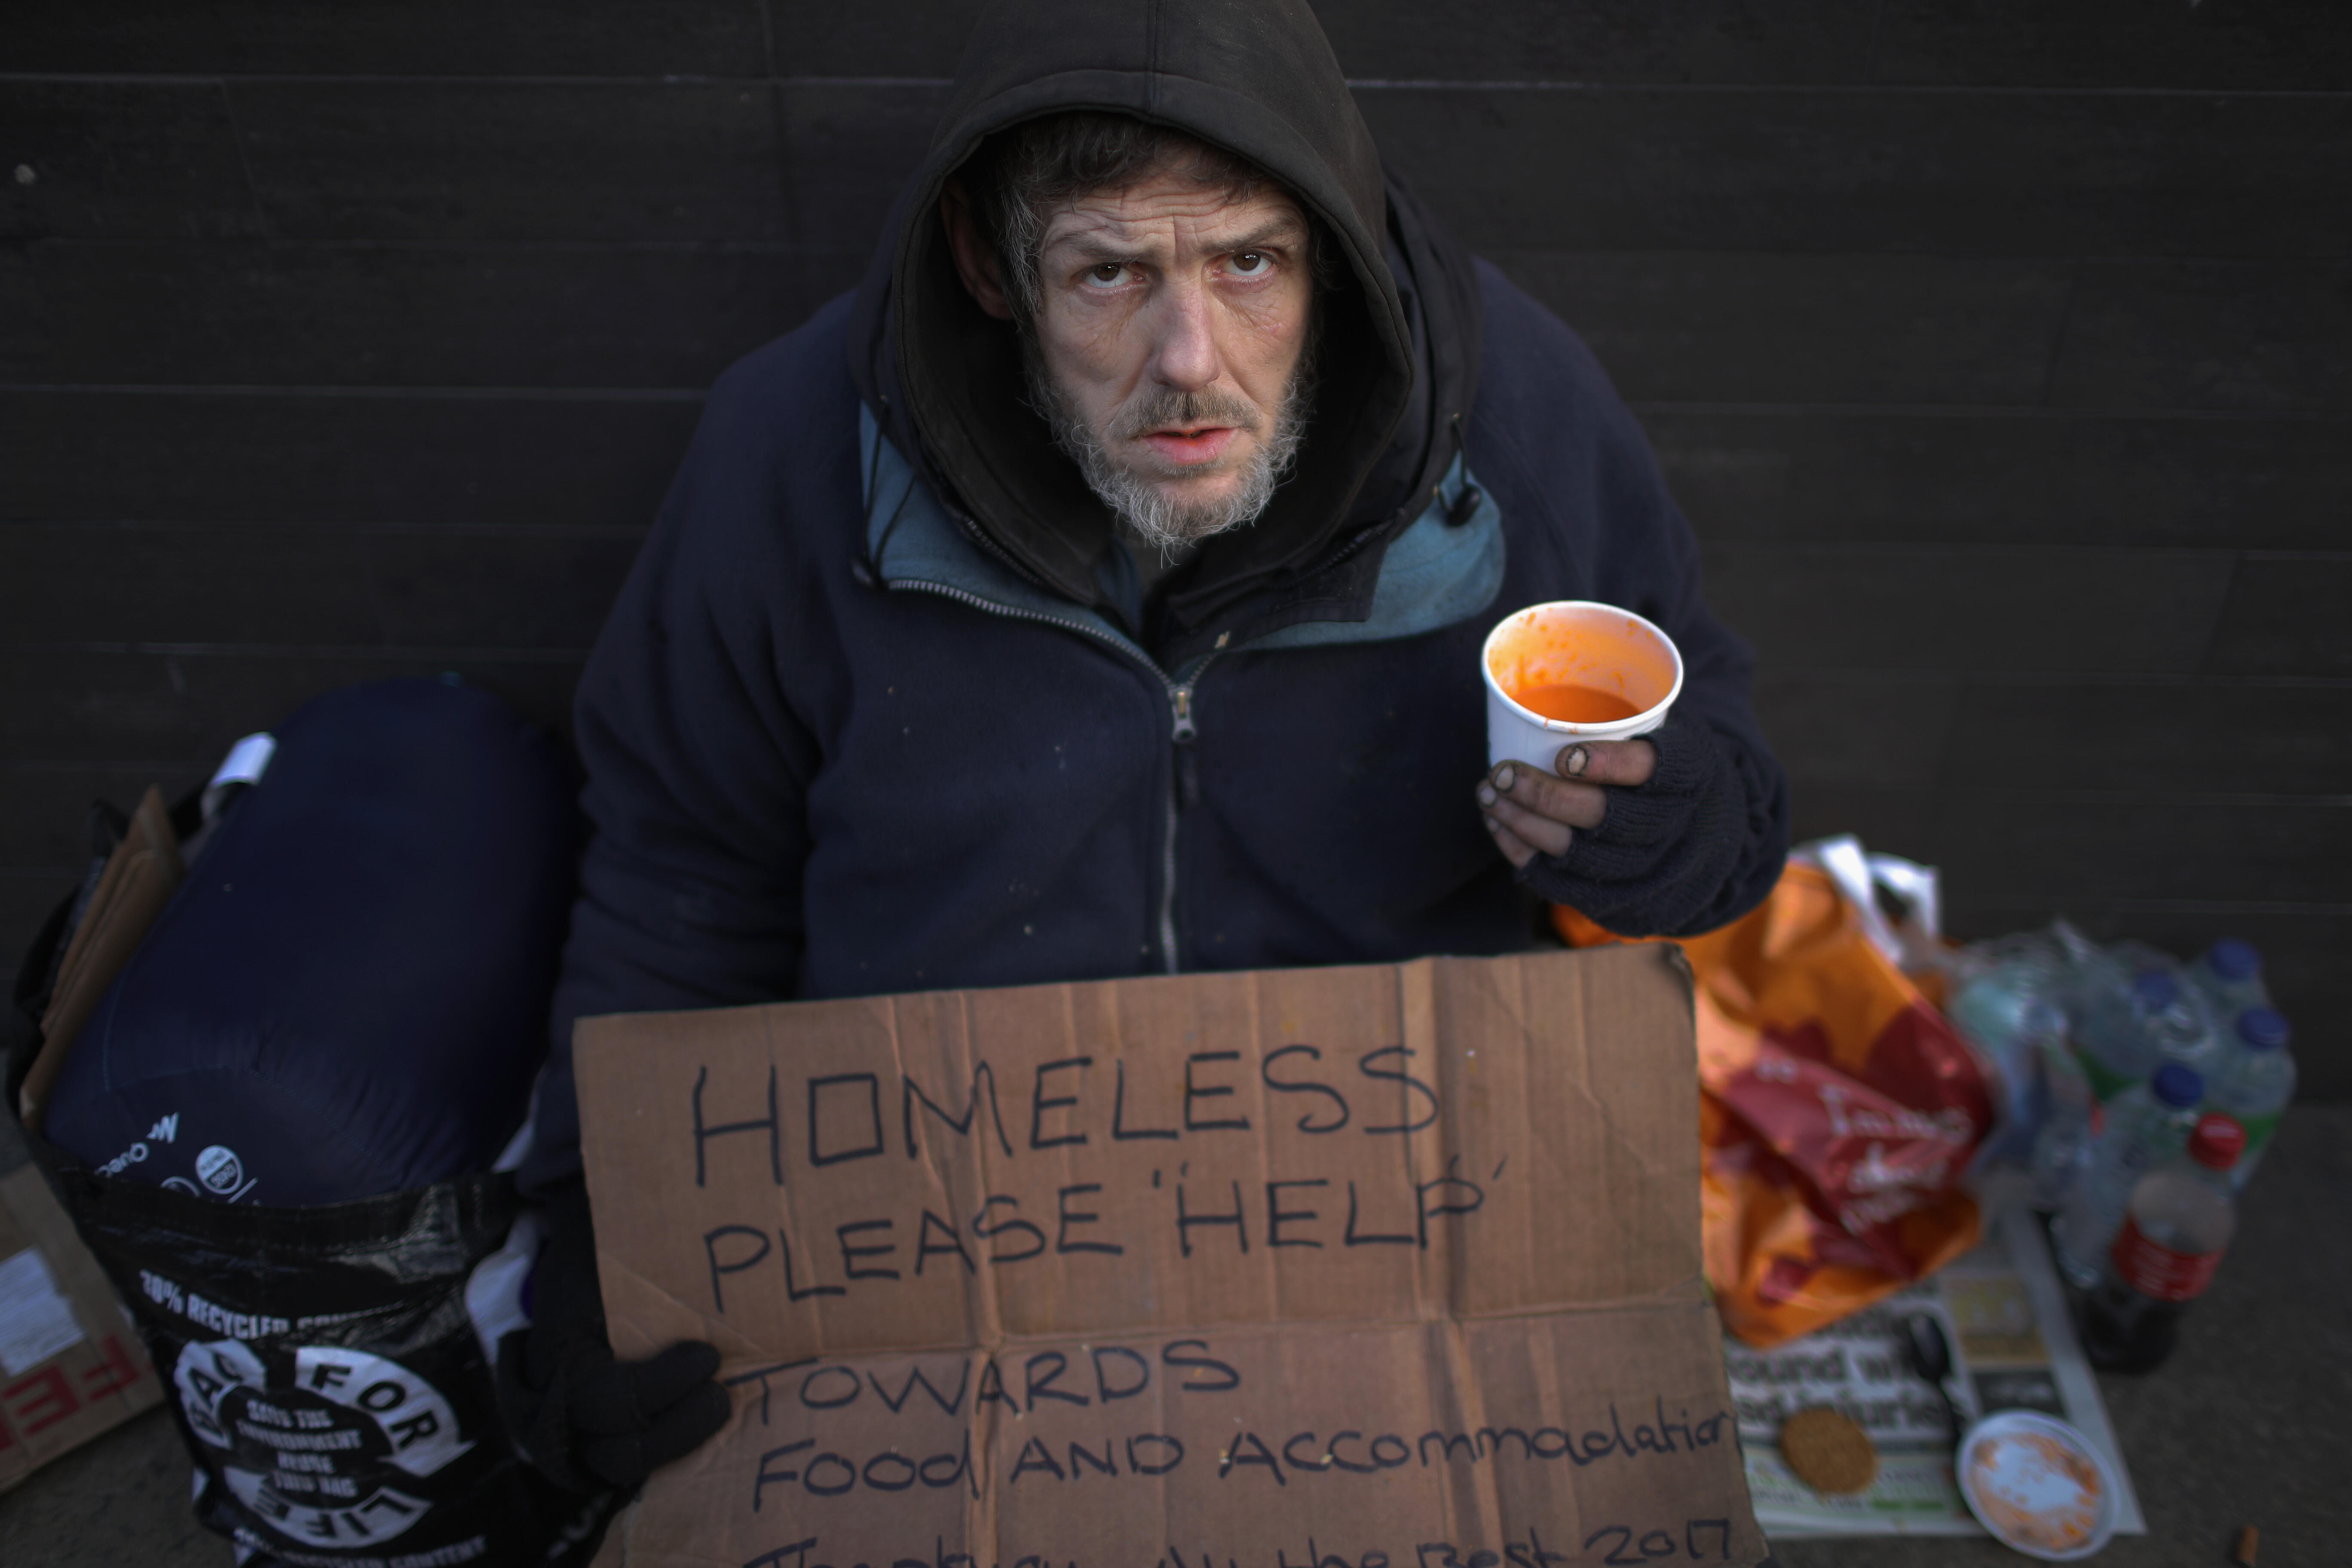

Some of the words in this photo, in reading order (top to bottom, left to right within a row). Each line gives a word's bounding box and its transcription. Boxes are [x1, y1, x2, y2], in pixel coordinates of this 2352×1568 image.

[693, 1044, 1438, 1187] HOMELESS
[95, 1141, 150, 1179] Quec
[703, 1184, 1124, 1314] PLEASE
[0, 1334, 143, 1452] FE
[292, 1408, 335, 1430] THE
[309, 1363, 438, 1449] FOR
[723, 1339, 1240, 1425] TOWARDS
[235, 1418, 364, 1451] ENVIRONMENT
[1010, 1434, 1185, 1484] AND
[257, 1474, 412, 1538] LIFE
